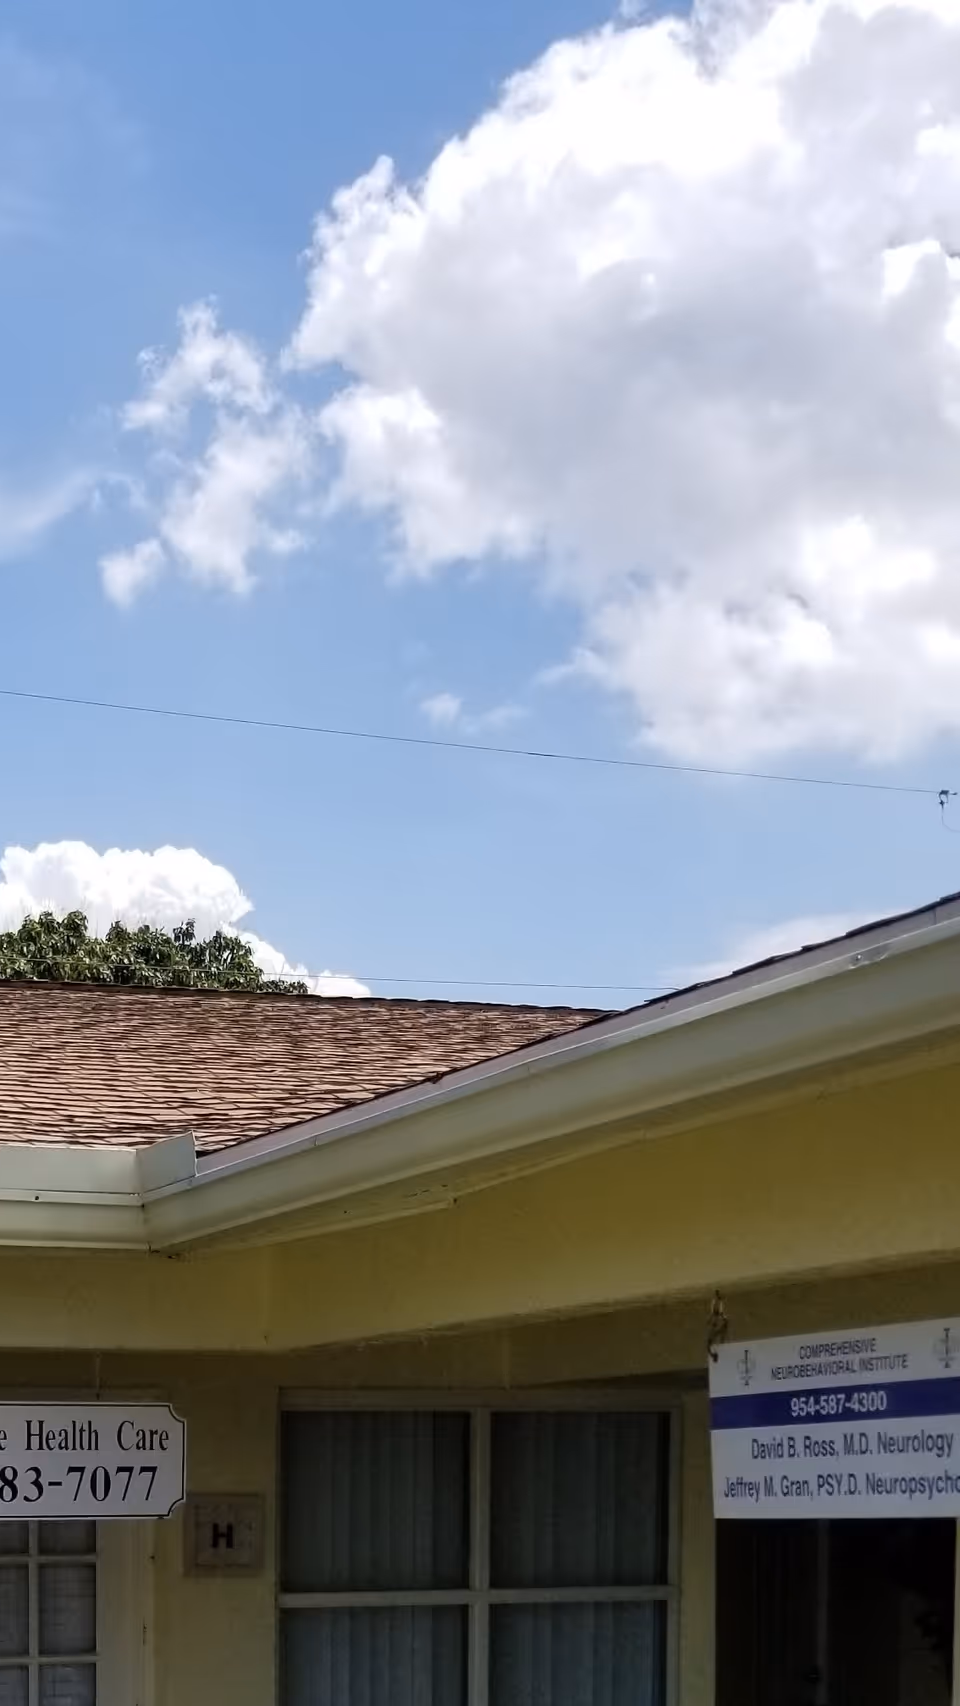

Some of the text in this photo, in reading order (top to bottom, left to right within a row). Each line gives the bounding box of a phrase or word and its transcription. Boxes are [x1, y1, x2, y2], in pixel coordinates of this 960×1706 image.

[799, 1337, 877, 1360] COMPREHENSIVE
[771, 1354, 908, 1381] NEUROBEHAVIORAL INSTITUTE
[791, 1390, 888, 1417] 954-587-4300
[24, 1419, 99, 1451] Health
[116, 1420, 170, 1451] Care
[751, 1429, 954, 1460] David B. Ross, M.D. Neurology
[724, 1475, 761, 1503] Jeffrey
[764, 1475, 778, 1498] M.
[780, 1474, 814, 1500] Gran,
[817, 1473, 861, 1496] PSY.D.
[212, 1523, 234, 1549] H
